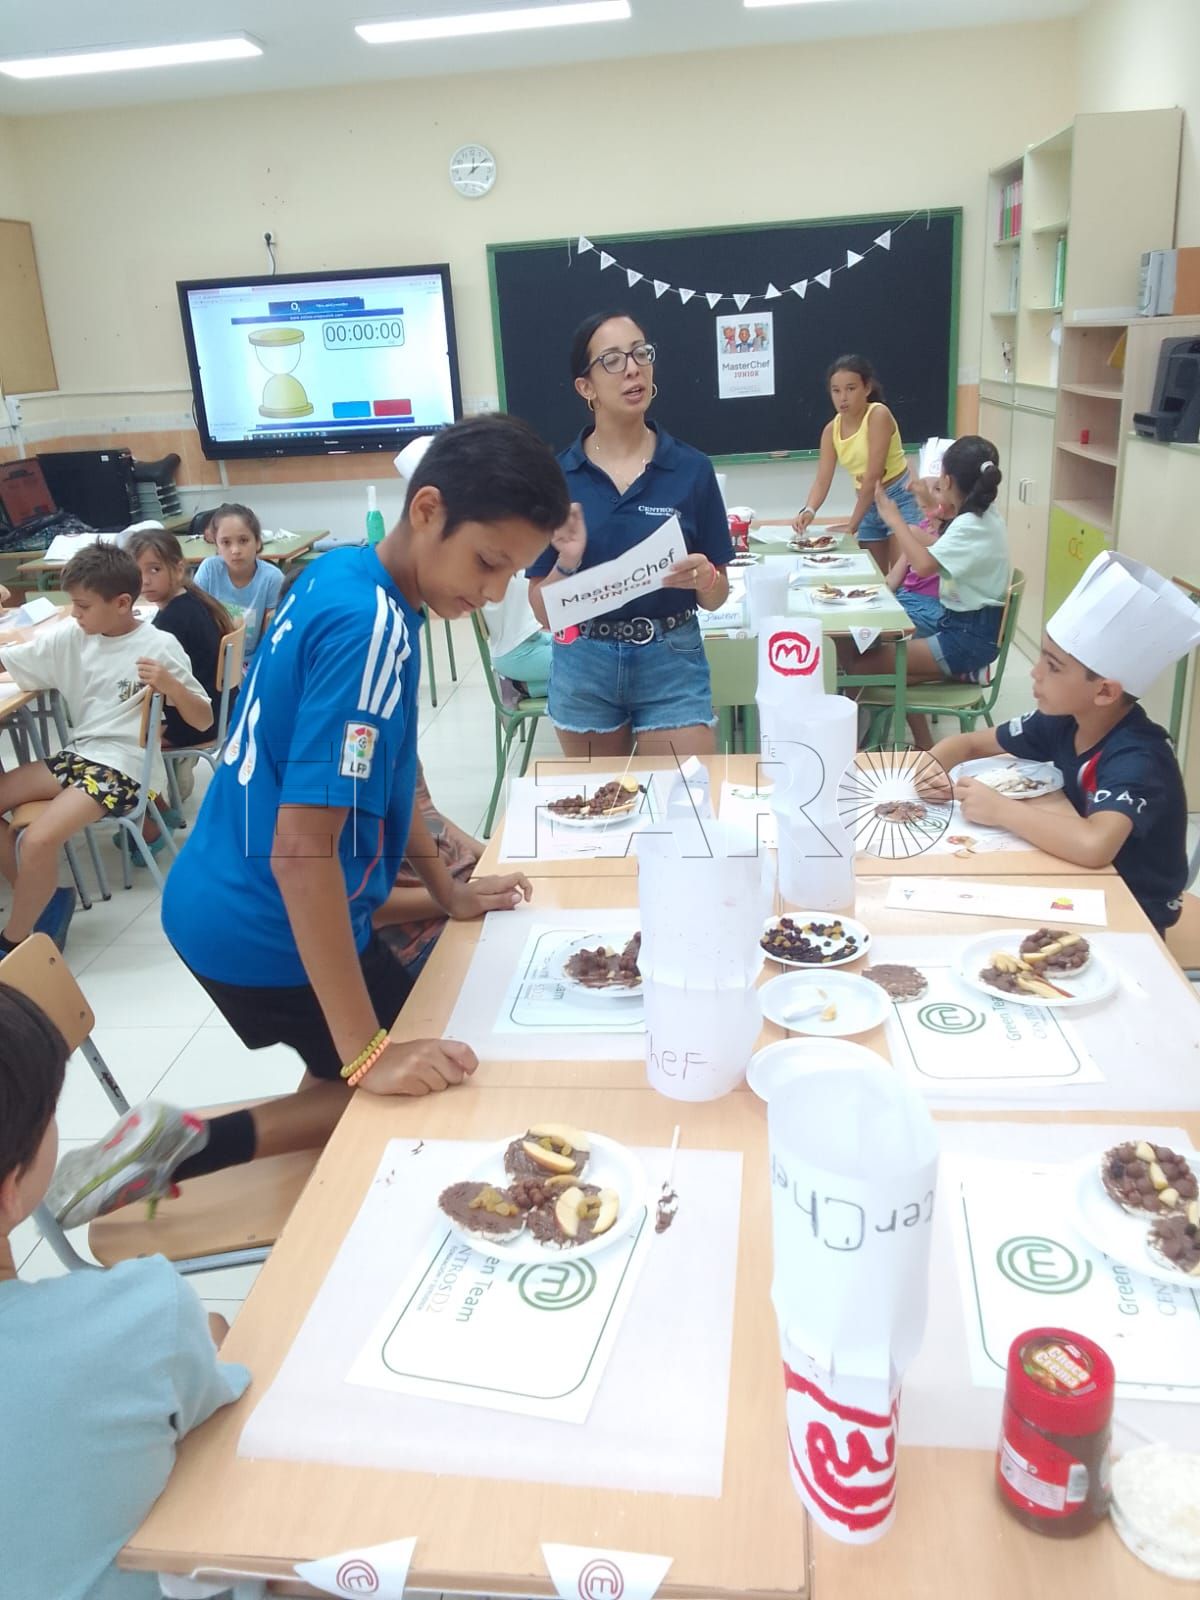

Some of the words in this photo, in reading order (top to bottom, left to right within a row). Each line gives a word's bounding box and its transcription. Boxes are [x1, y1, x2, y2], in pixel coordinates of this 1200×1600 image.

[325, 321, 401, 342] 00:00:00
[722, 360, 770, 371] MasterChef
[734, 371, 760, 379] JUNIOR
[560, 547, 676, 607] MasterChef
[591, 579, 652, 604] JUNIOR
[455, 1279, 494, 1323] Team
[1111, 1264, 1140, 1316] Green
